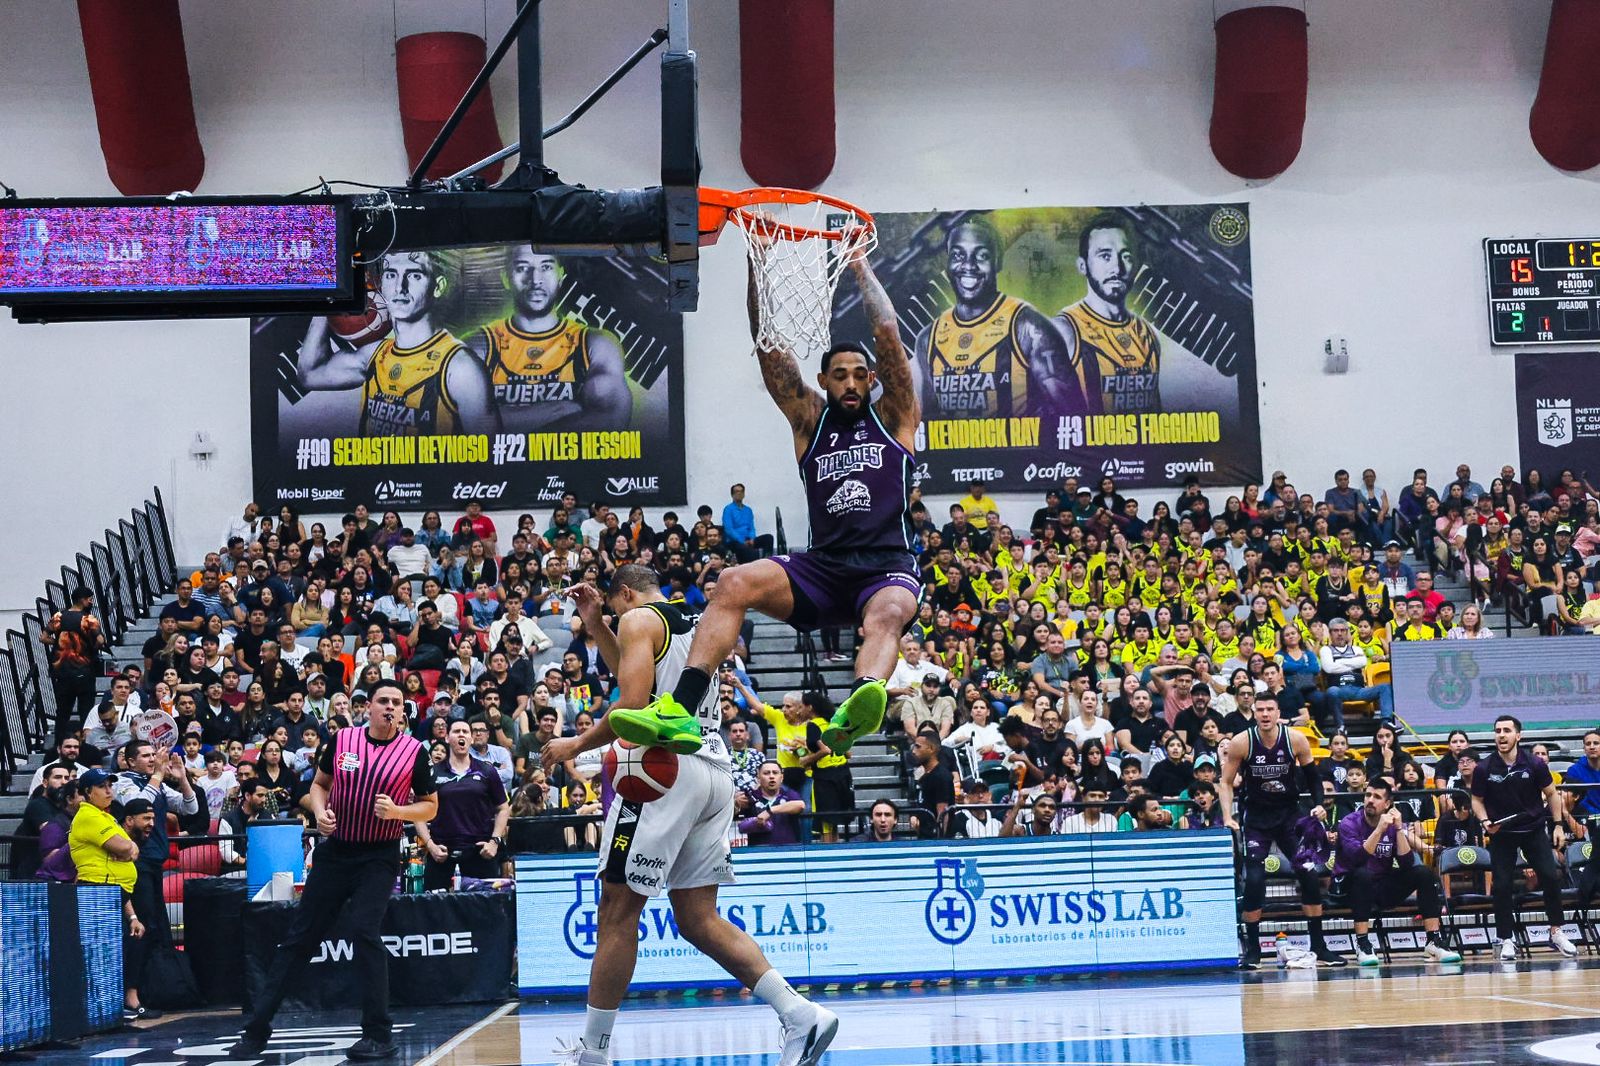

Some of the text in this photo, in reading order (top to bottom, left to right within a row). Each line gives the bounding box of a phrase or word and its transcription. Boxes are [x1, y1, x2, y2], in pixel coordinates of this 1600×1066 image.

[1494, 243, 1530, 254] LOCAL
[1511, 259, 1533, 282] 15
[1512, 287, 1540, 296] BONUS
[1557, 280, 1594, 289] PERIODO
[1496, 303, 1526, 311] FALTAS
[1557, 301, 1589, 310] JUGADOR
[1511, 312, 1523, 331] 2
[1537, 332, 1553, 341] TFR
[933, 372, 996, 393] FUERZA
[494, 381, 574, 403] FUERZA
[938, 391, 987, 411] REGIA
[1536, 398, 1554, 408] NL
[928, 417, 1006, 450] KENDRICK
[1010, 416, 1040, 448] RAY
[1057, 411, 1220, 450] #3 LUCAS FAGGIANO
[829, 433, 839, 447] 7
[296, 438, 331, 470] #99
[418, 434, 488, 464] REYNOSO
[493, 431, 641, 465] #22 MYLES HESSON
[952, 468, 994, 482] TECATE
[1038, 462, 1081, 480] coflex
[1119, 466, 1144, 474] Ahorro
[1165, 458, 1214, 479] gowin
[546, 475, 564, 487] Tim
[277, 489, 344, 500] Mobil Super
[393, 488, 422, 498] Ahorro
[452, 481, 507, 499] telcel
[826, 499, 871, 514] VERACRUZ
[1255, 755, 1266, 763] 32
[632, 854, 665, 869] Sprite
[628, 872, 660, 887] telcel
[991, 930, 1066, 944] Laboratorios
[1071, 929, 1085, 939] de
